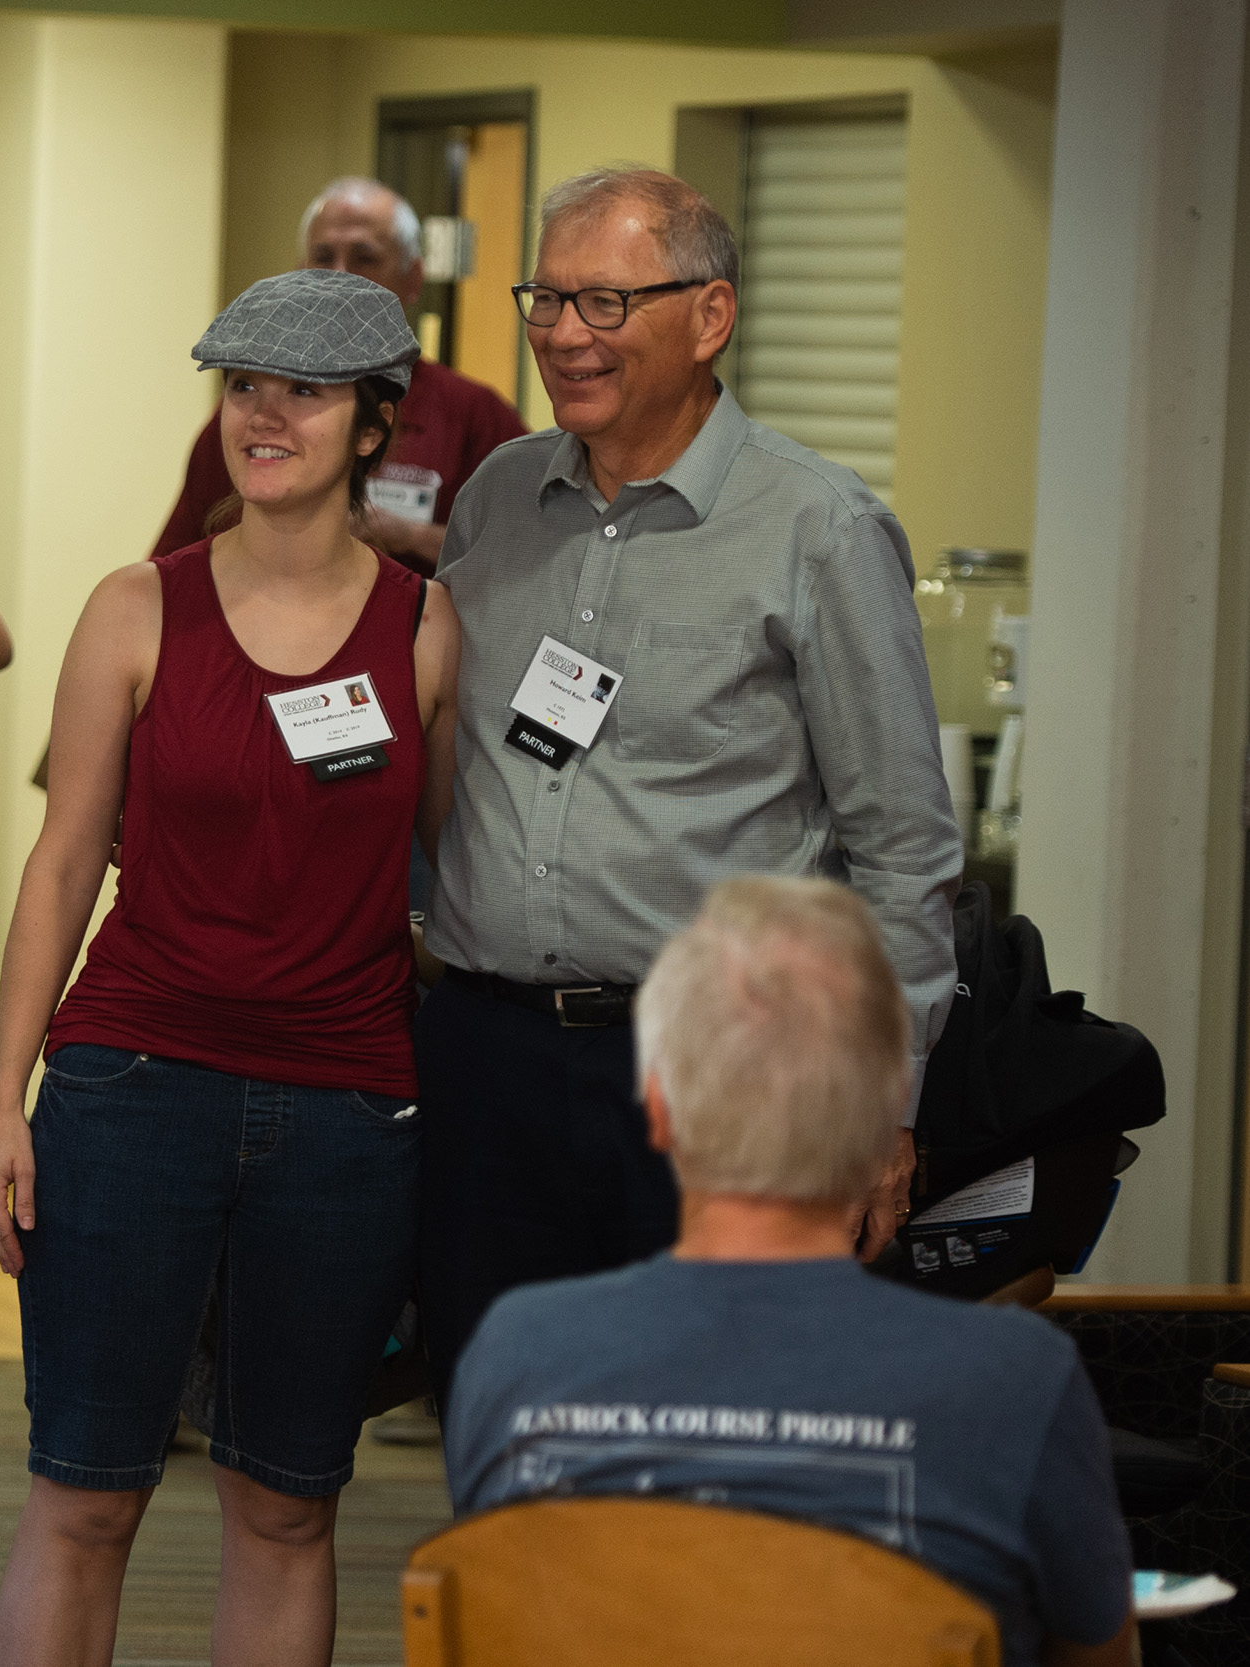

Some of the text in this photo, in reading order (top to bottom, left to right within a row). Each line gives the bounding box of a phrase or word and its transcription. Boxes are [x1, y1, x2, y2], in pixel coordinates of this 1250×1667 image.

[542, 654, 575, 676] COLLEGE
[545, 648, 578, 670] HESSTON
[279, 695, 320, 709] HESSTON
[549, 679, 587, 704] Howard Keim
[281, 701, 323, 714] COLLEGE
[293, 718, 312, 728] Kayla
[312, 710, 350, 725] (Kauffman)
[350, 707, 368, 716] Rudy
[518, 731, 556, 757] PARTNER
[327, 755, 375, 772] PARTNER
[652, 1403, 773, 1441] COURSE
[777, 1409, 916, 1452] PROFILE
